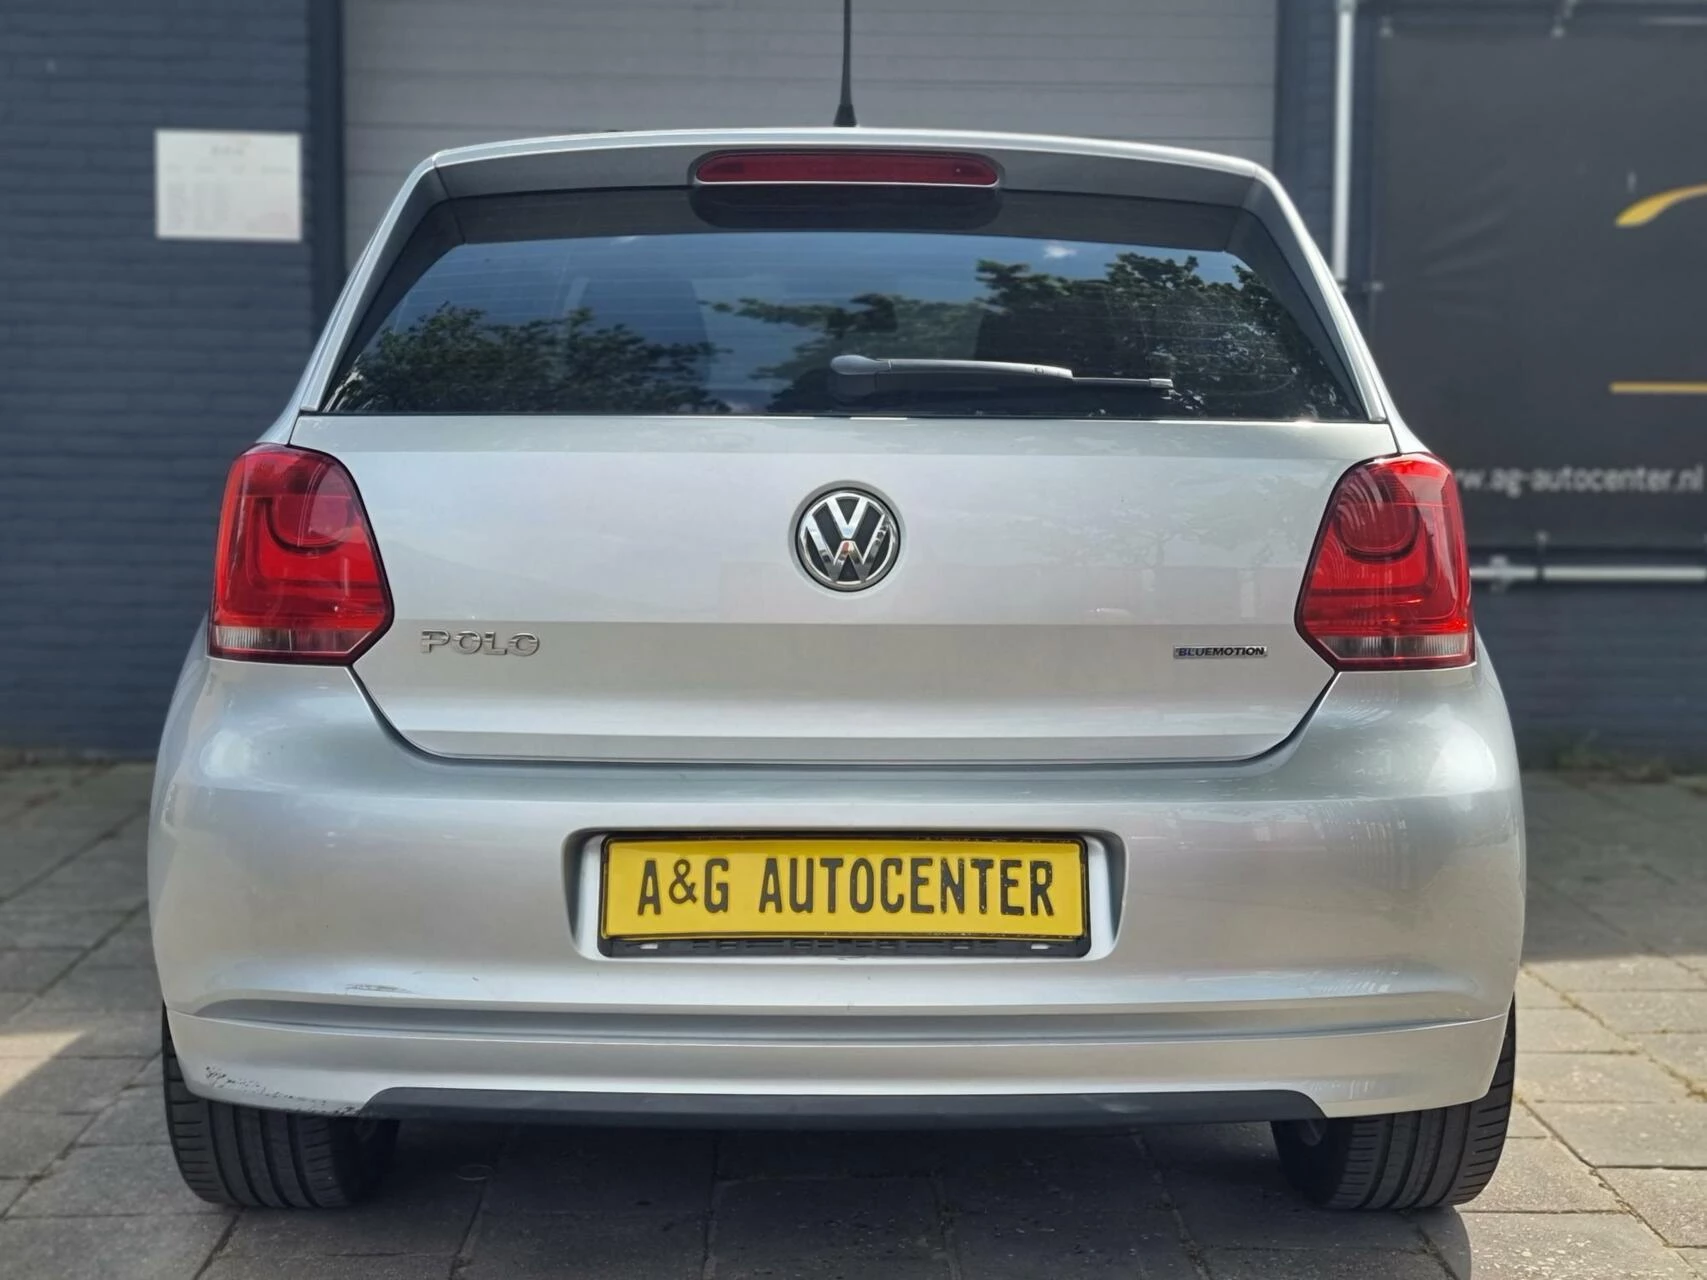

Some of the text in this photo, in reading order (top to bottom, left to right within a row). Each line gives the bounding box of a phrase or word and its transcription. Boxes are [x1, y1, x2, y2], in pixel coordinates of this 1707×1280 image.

[421, 629, 540, 657] POLO
[1177, 646, 1265, 657] BLUEMOTION
[637, 857, 1055, 917] A&G AUTOCENTER
